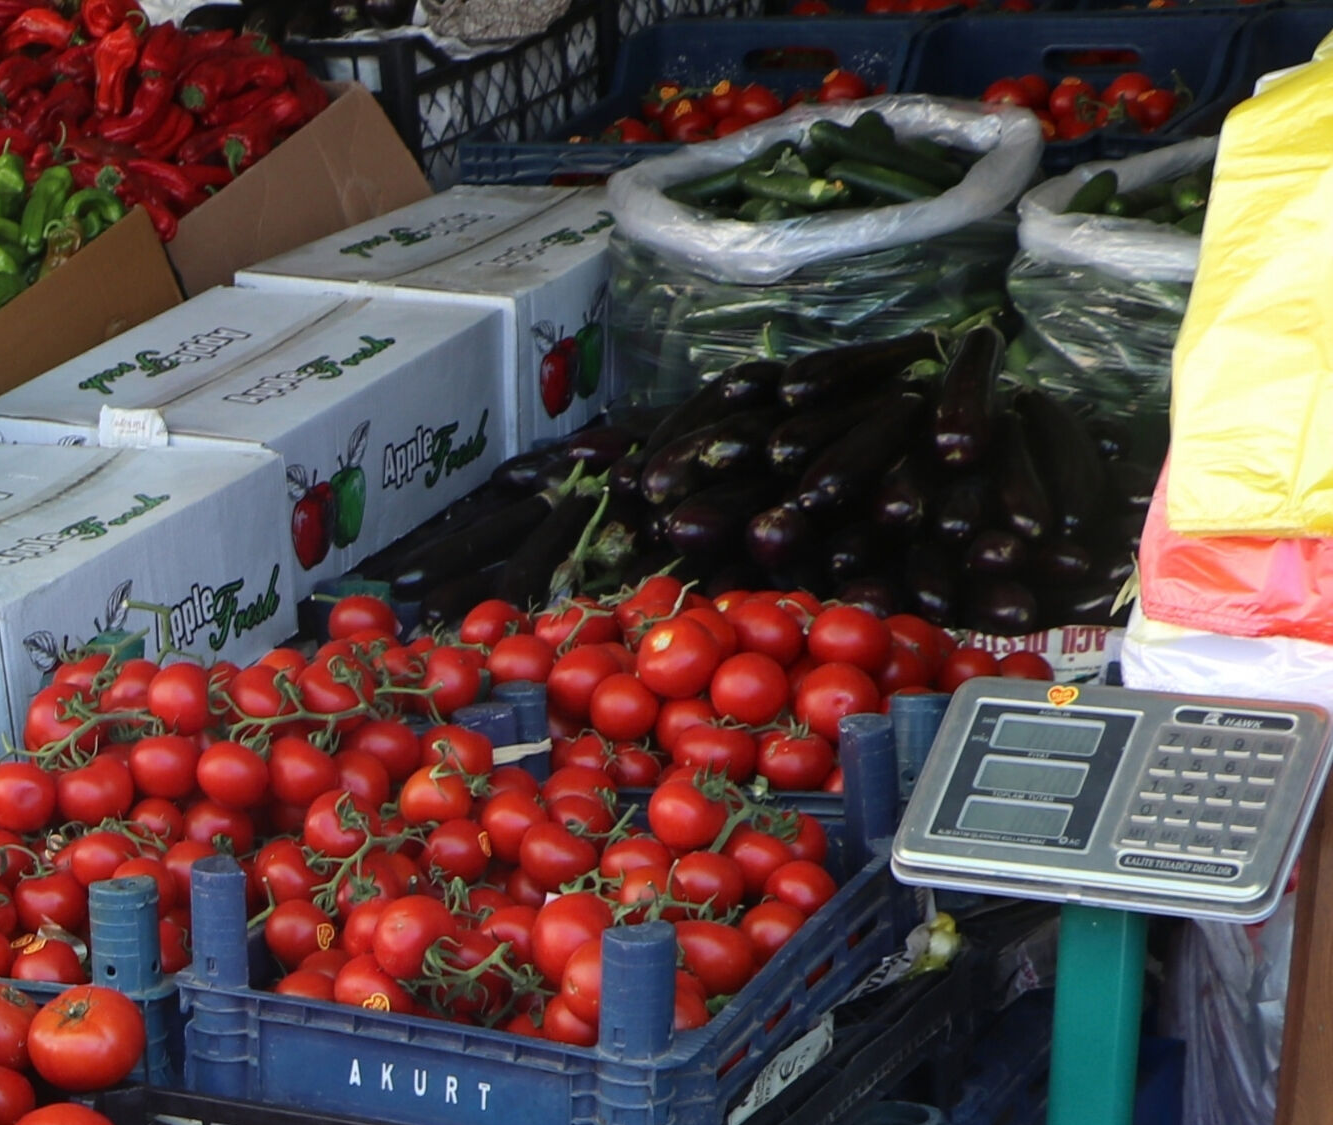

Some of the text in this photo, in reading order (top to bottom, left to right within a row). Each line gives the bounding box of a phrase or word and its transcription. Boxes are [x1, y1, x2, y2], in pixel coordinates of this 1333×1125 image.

[79, 326, 252, 394] Apple Fresh
[223, 336, 396, 404] Apple Fresh
[383, 409, 489, 489] Apple Fresh
[61, 493, 171, 541] Fresh
[209, 564, 281, 651] Fresh
[1222, 717, 1264, 730] HAWK
[1168, 733, 1245, 750] 7 8 9
[1158, 756, 1236, 773] 4 5 6
[1182, 783, 1195, 795] 2
[1214, 785, 1228, 798] 3
[1139, 803, 1152, 815] 0
[1124, 856, 1153, 868] KALİTE
[349, 1058, 491, 1111] AKURT
